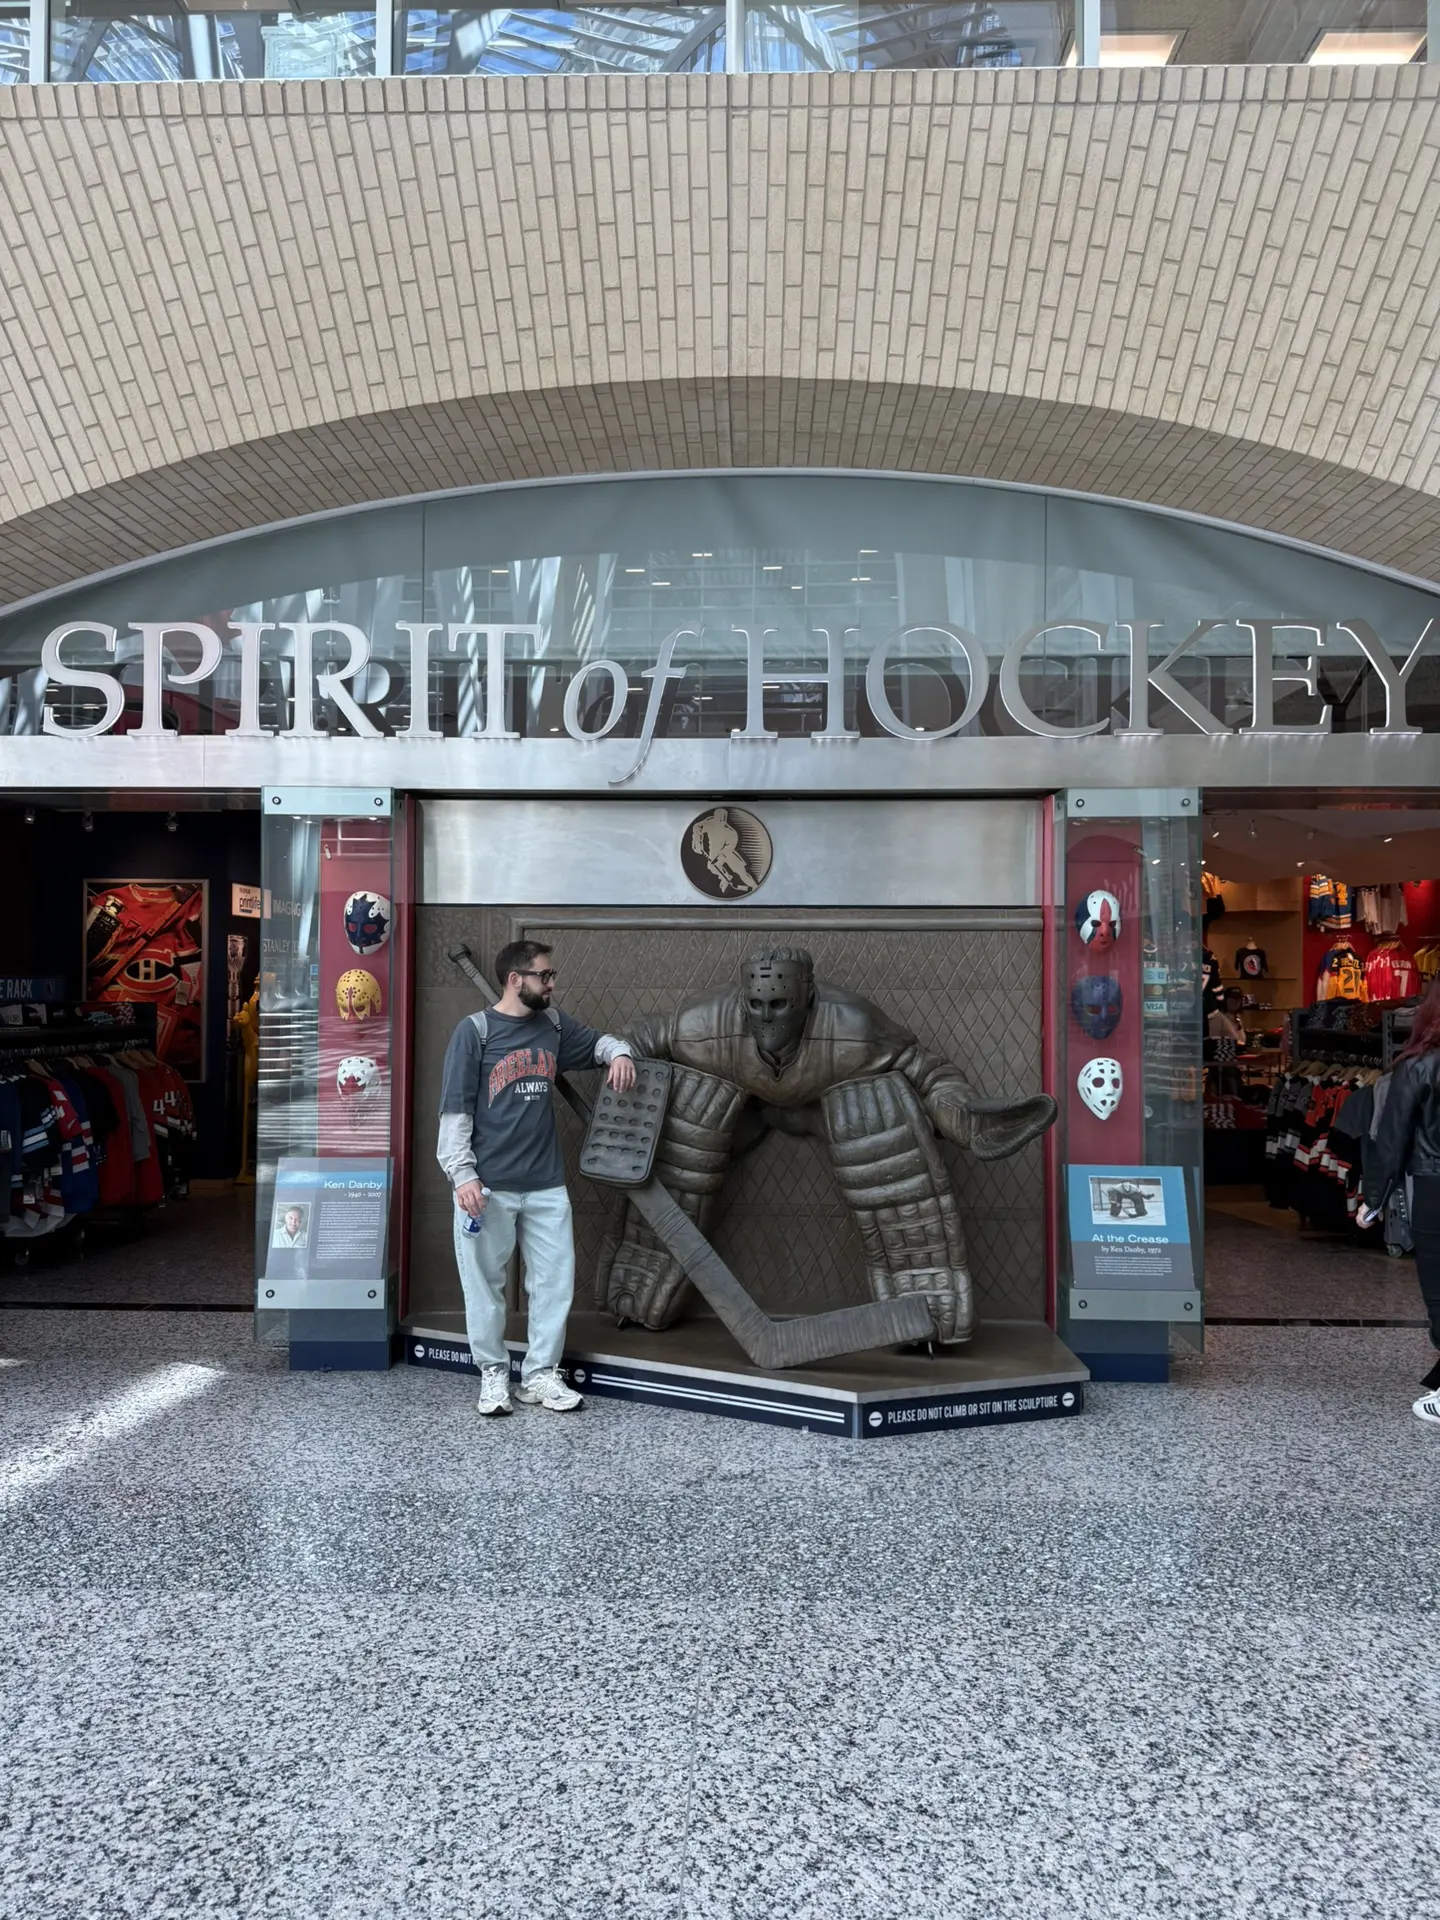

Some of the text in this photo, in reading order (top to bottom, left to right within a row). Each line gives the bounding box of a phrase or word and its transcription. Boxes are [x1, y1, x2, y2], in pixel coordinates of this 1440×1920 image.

[41, 618, 1440, 786] SPIRIT of HOCKEY
[263, 939, 291, 953] STANLEY
[6, 979, 33, 998] RACK
[1146, 1003, 1164, 1011] VISA
[514, 1081, 548, 1094] ALWAYS
[323, 1180, 383, 1190] Ken Danby
[367, 1191, 382, 1199] 2007
[1092, 1233, 1169, 1244] At the Crease
[1101, 1245, 1109, 1254] by
[1110, 1245, 1123, 1253] Ken
[1147, 1246, 1162, 1254] 1972
[428, 1347, 451, 1361] PLEASE
[451, 1350, 460, 1362] DO
[460, 1351, 472, 1364] NOT
[888, 1395, 1058, 1424] PLEASE DO NOT CLIMB OR SIT ON THE SCULPTURE
